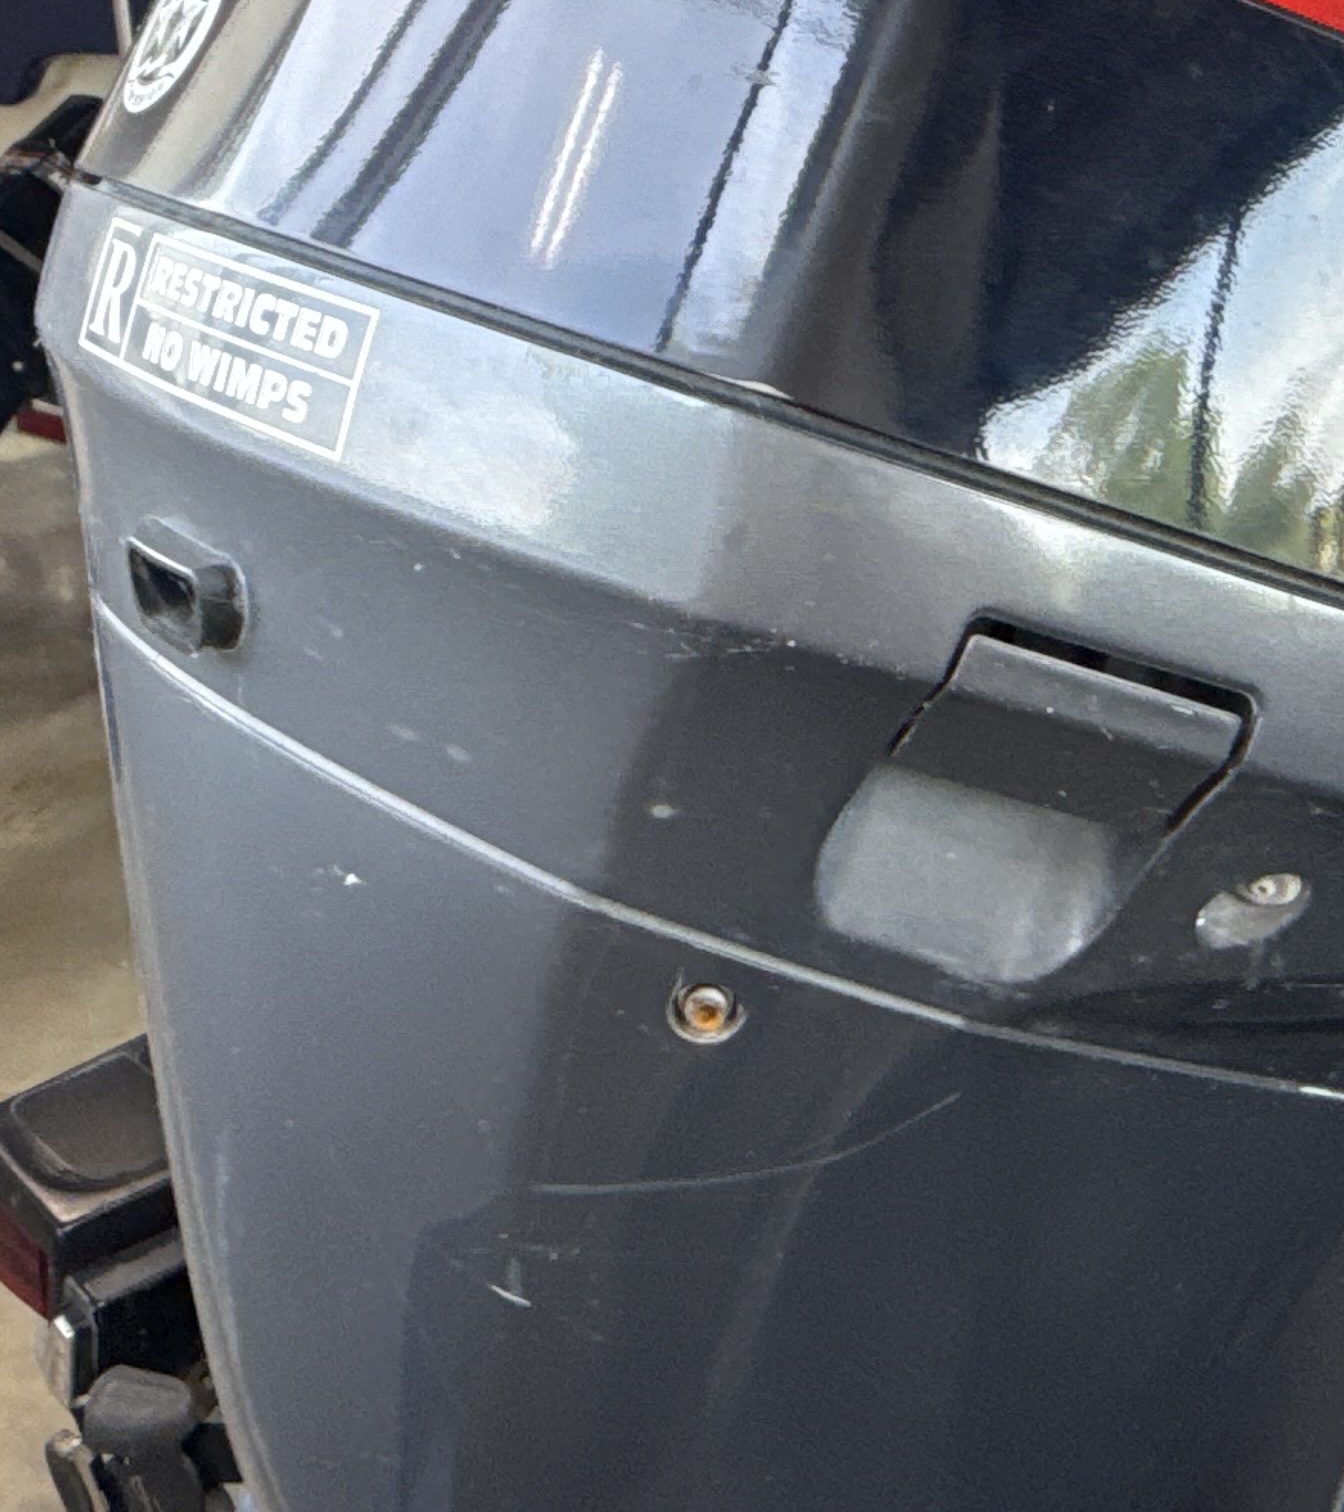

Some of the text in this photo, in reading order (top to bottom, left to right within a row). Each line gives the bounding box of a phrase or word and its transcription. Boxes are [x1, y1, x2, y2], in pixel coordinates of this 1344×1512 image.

[88, 238, 350, 360] R RESTRICTED
[142, 321, 313, 425] NO WIMPS
